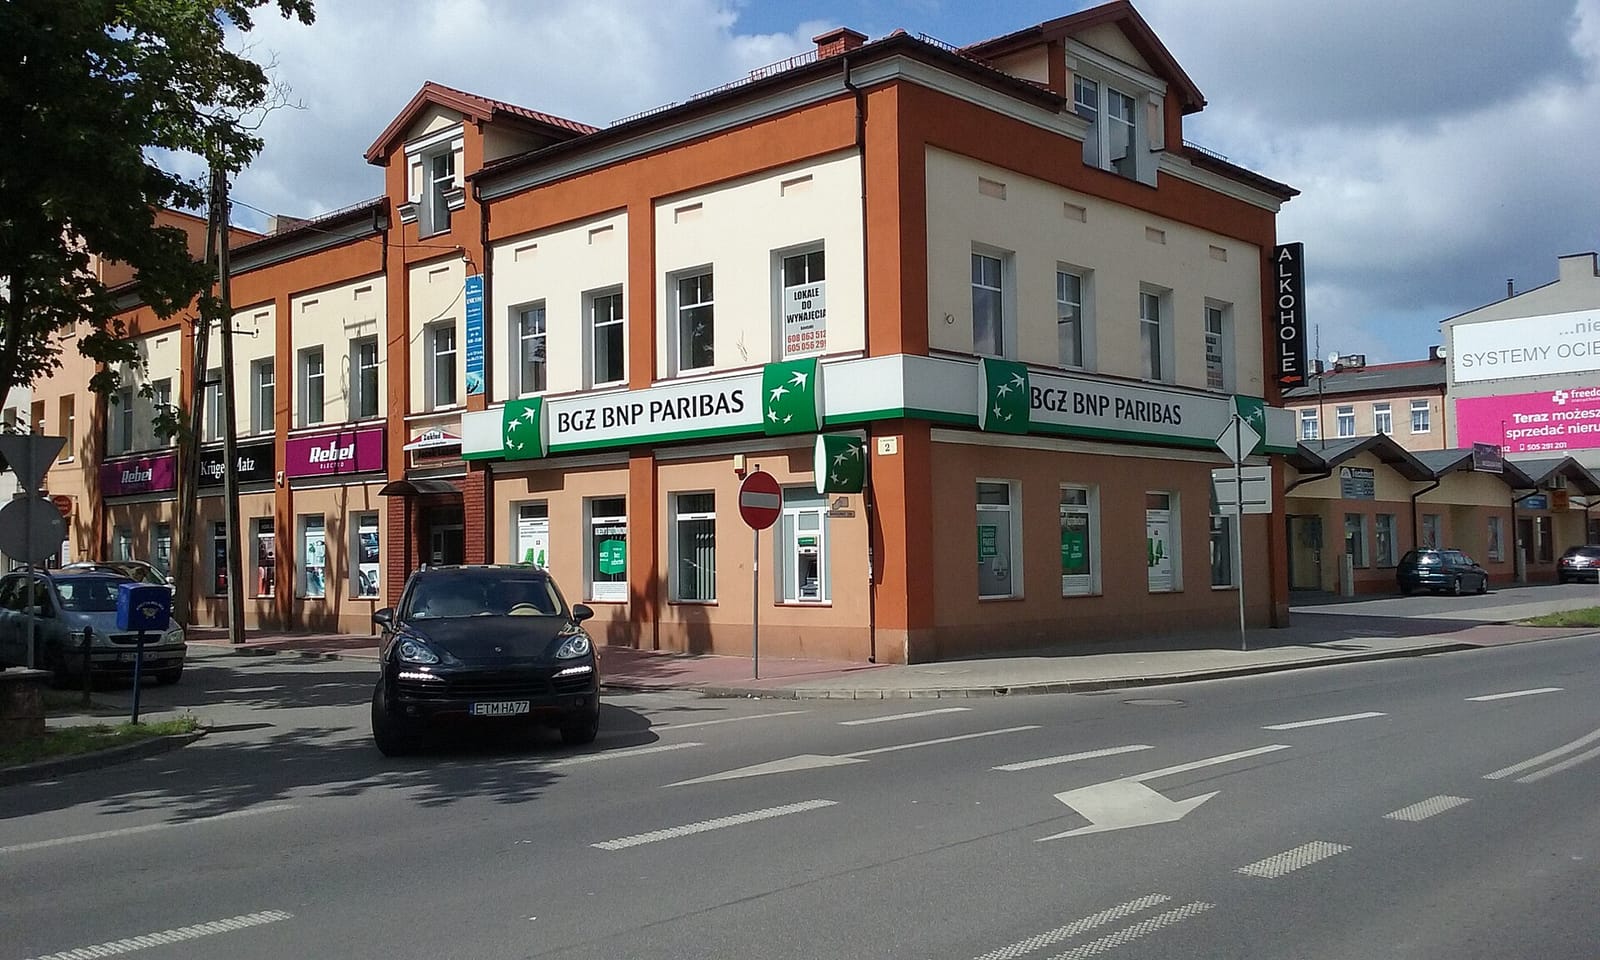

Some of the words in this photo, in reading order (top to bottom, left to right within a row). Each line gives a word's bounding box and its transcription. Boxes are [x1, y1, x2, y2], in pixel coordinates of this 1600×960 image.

[793, 287, 820, 301] LOKALE
[801, 300, 812, 310] DO
[1278, 247, 1297, 373] ALKOHOLE
[1461, 345, 1551, 368] SYSTEMY
[557, 408, 597, 433] BGŻ
[602, 403, 644, 429] BNP
[649, 389, 745, 423] PARIBAS
[1030, 386, 1067, 413] BGŻ
[1073, 391, 1110, 417] BNP
[1114, 397, 1182, 426] PARIBAS
[1512, 412, 1549, 424] Teraz
[1552, 407, 1600, 421] możesz
[1505, 424, 1565, 440] sprzedać
[309, 440, 355, 463] Rebel
[884, 443, 891, 452] 2
[120, 465, 153, 484] Rebel
[200, 460, 225, 479] Krüge
[476, 703, 499, 714] ETM
[501, 701, 528, 714] HA77
